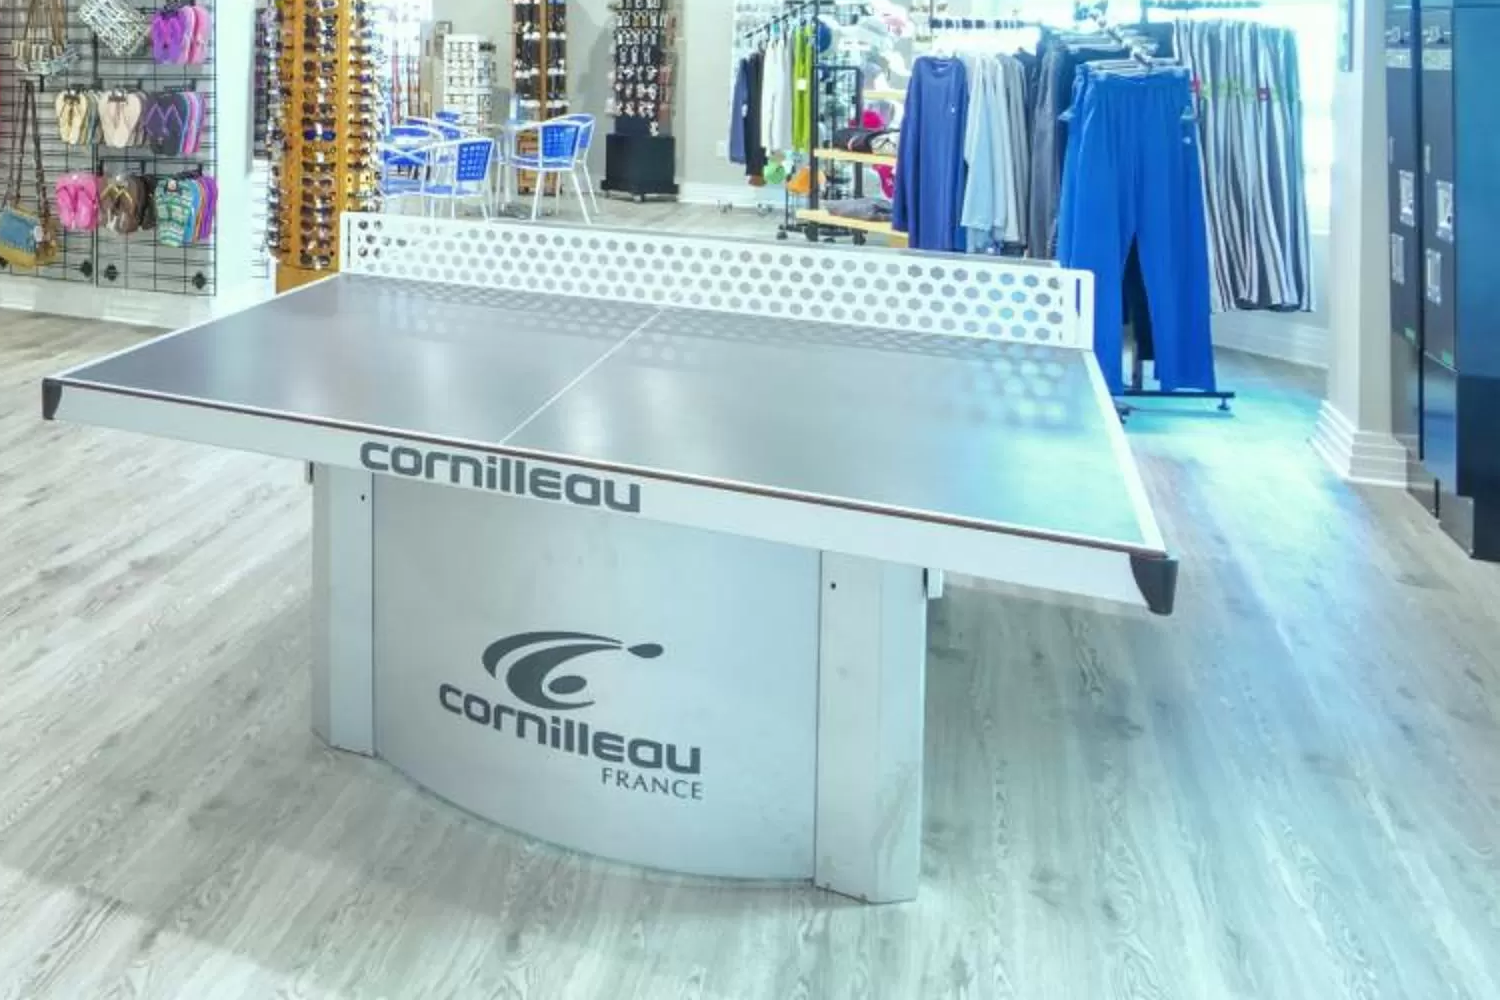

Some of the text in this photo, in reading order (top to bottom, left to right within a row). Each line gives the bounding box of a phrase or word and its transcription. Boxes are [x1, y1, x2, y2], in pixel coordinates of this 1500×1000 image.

[360, 441, 641, 513] cornilleau
[439, 683, 701, 775] cornilleau
[602, 767, 704, 800] FRANCE
